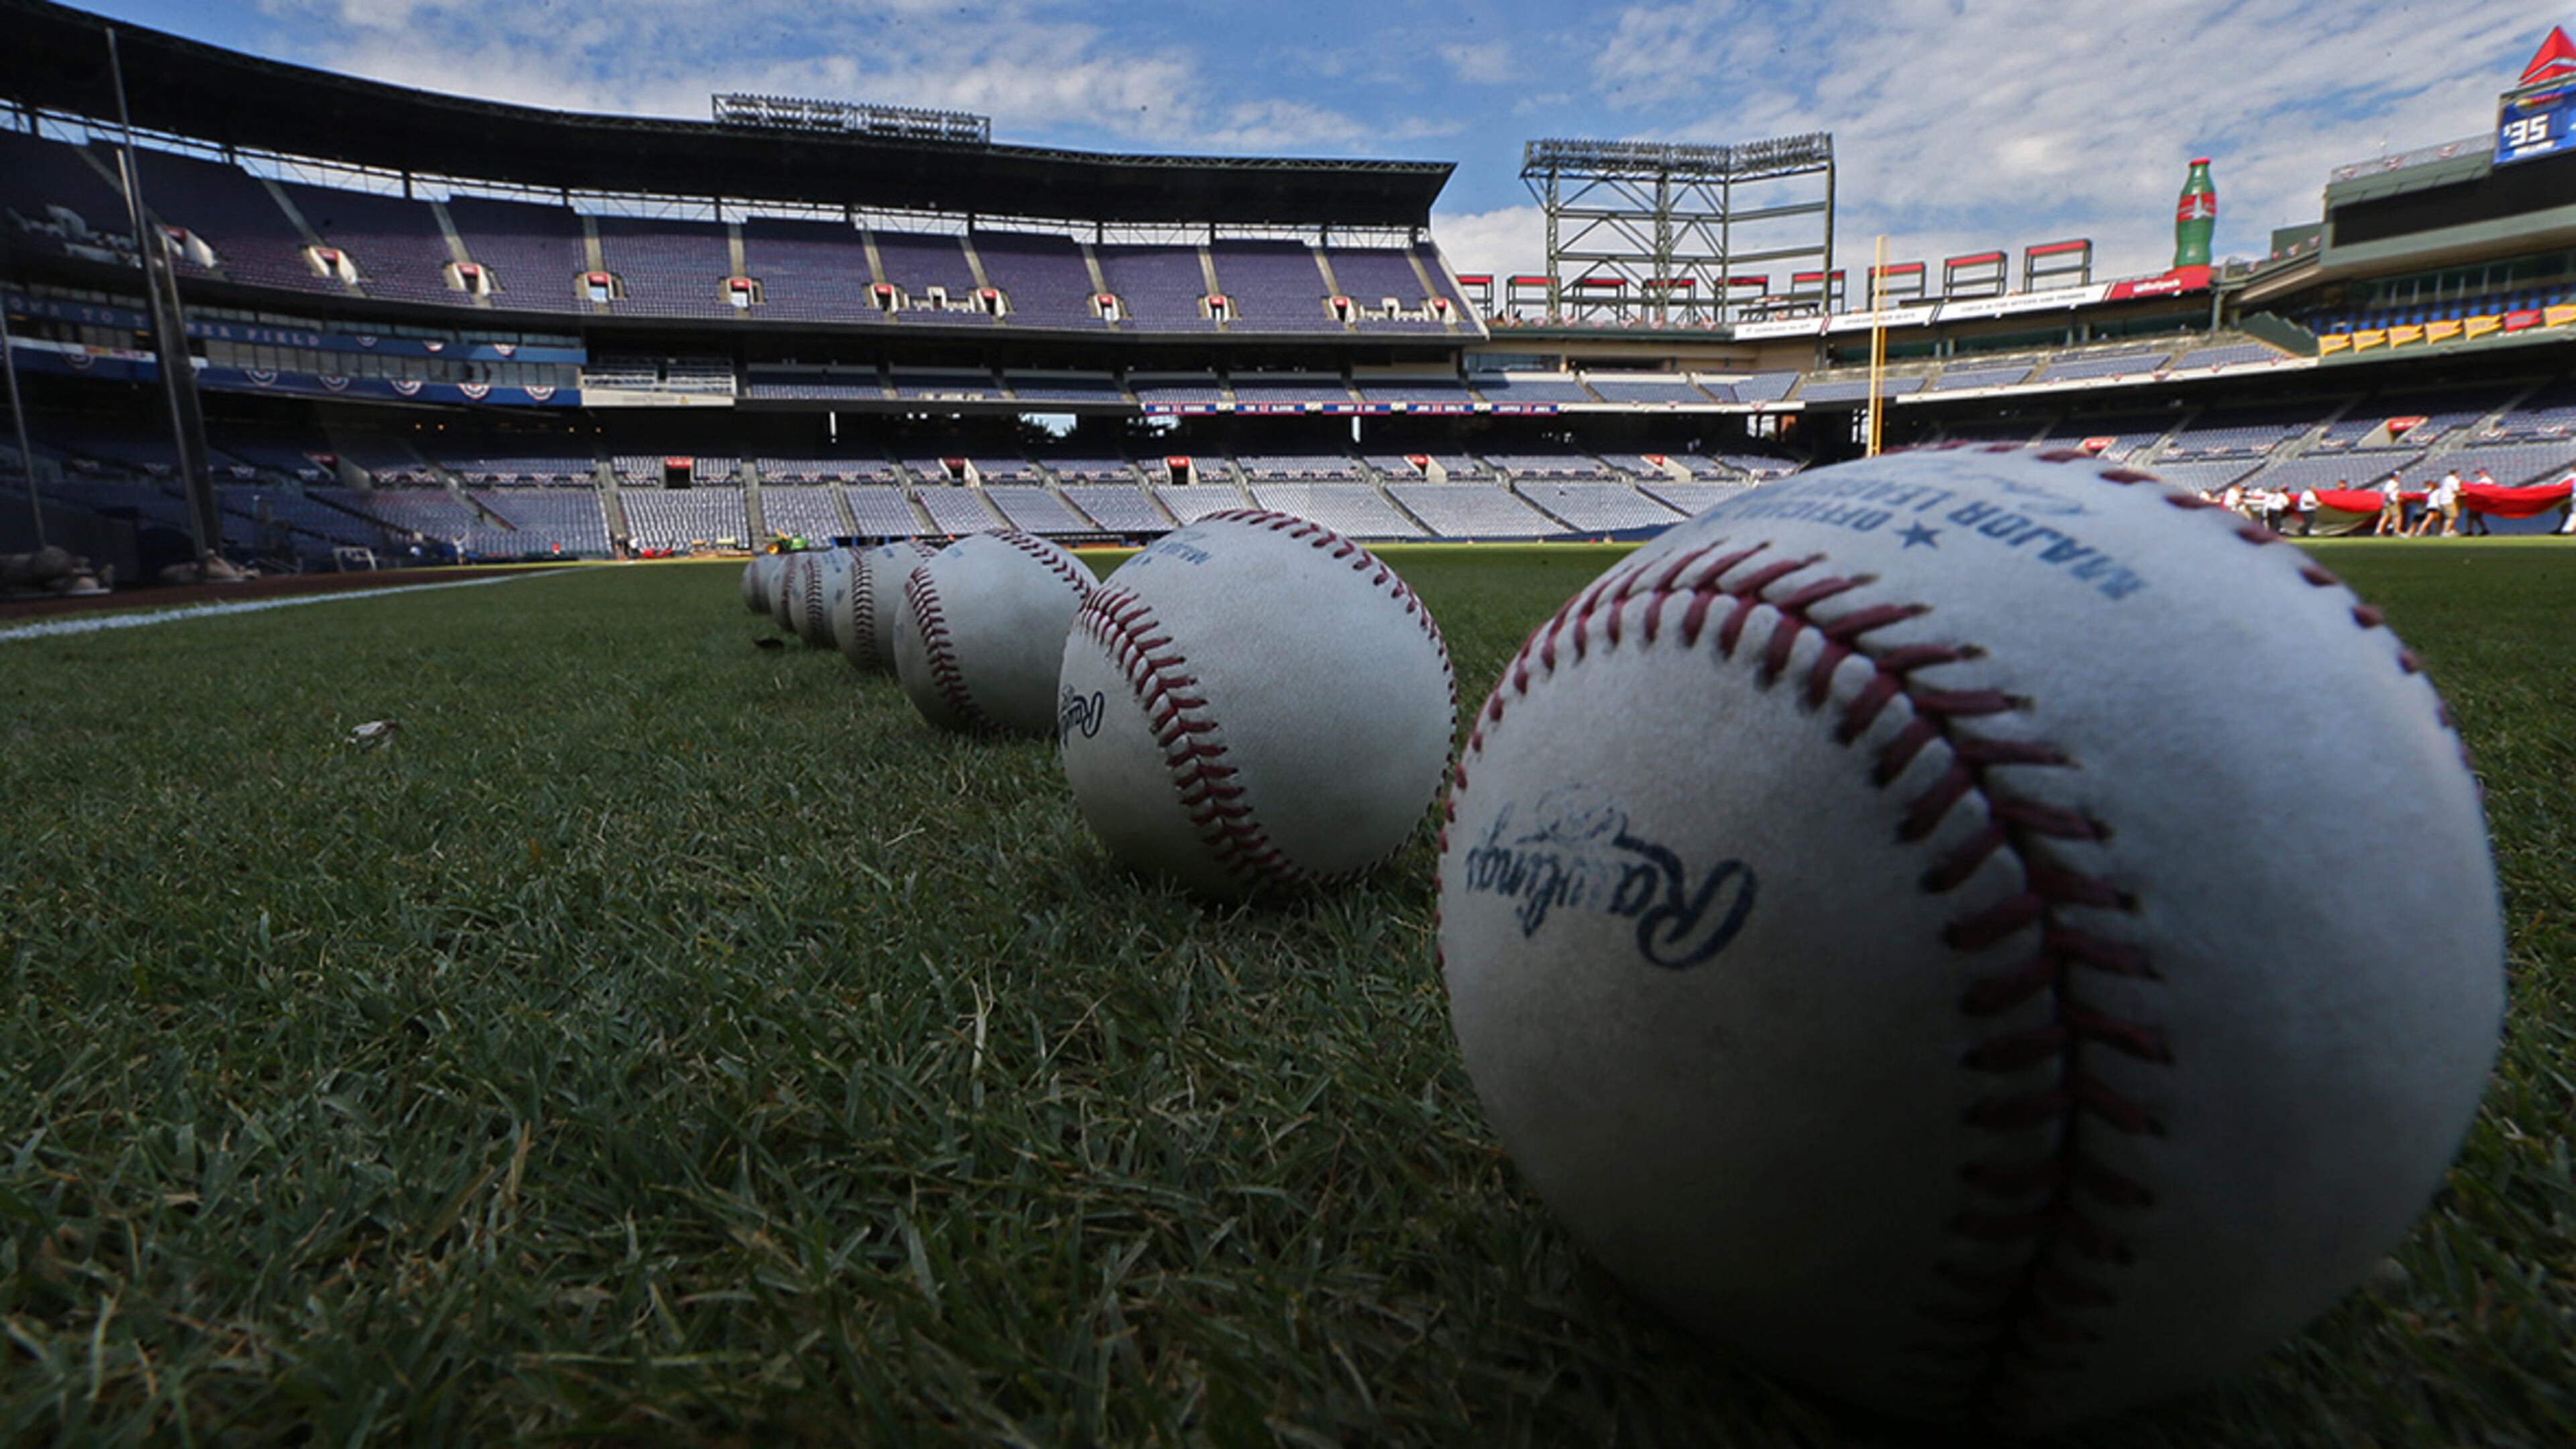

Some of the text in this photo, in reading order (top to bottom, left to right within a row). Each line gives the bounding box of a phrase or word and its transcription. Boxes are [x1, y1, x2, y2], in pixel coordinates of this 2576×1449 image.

[82, 308, 114, 323] TO
[246, 329, 320, 346] FIELD
[1946, 494, 2145, 600] MAJOR
[1465, 802, 1758, 971] Rawlings
